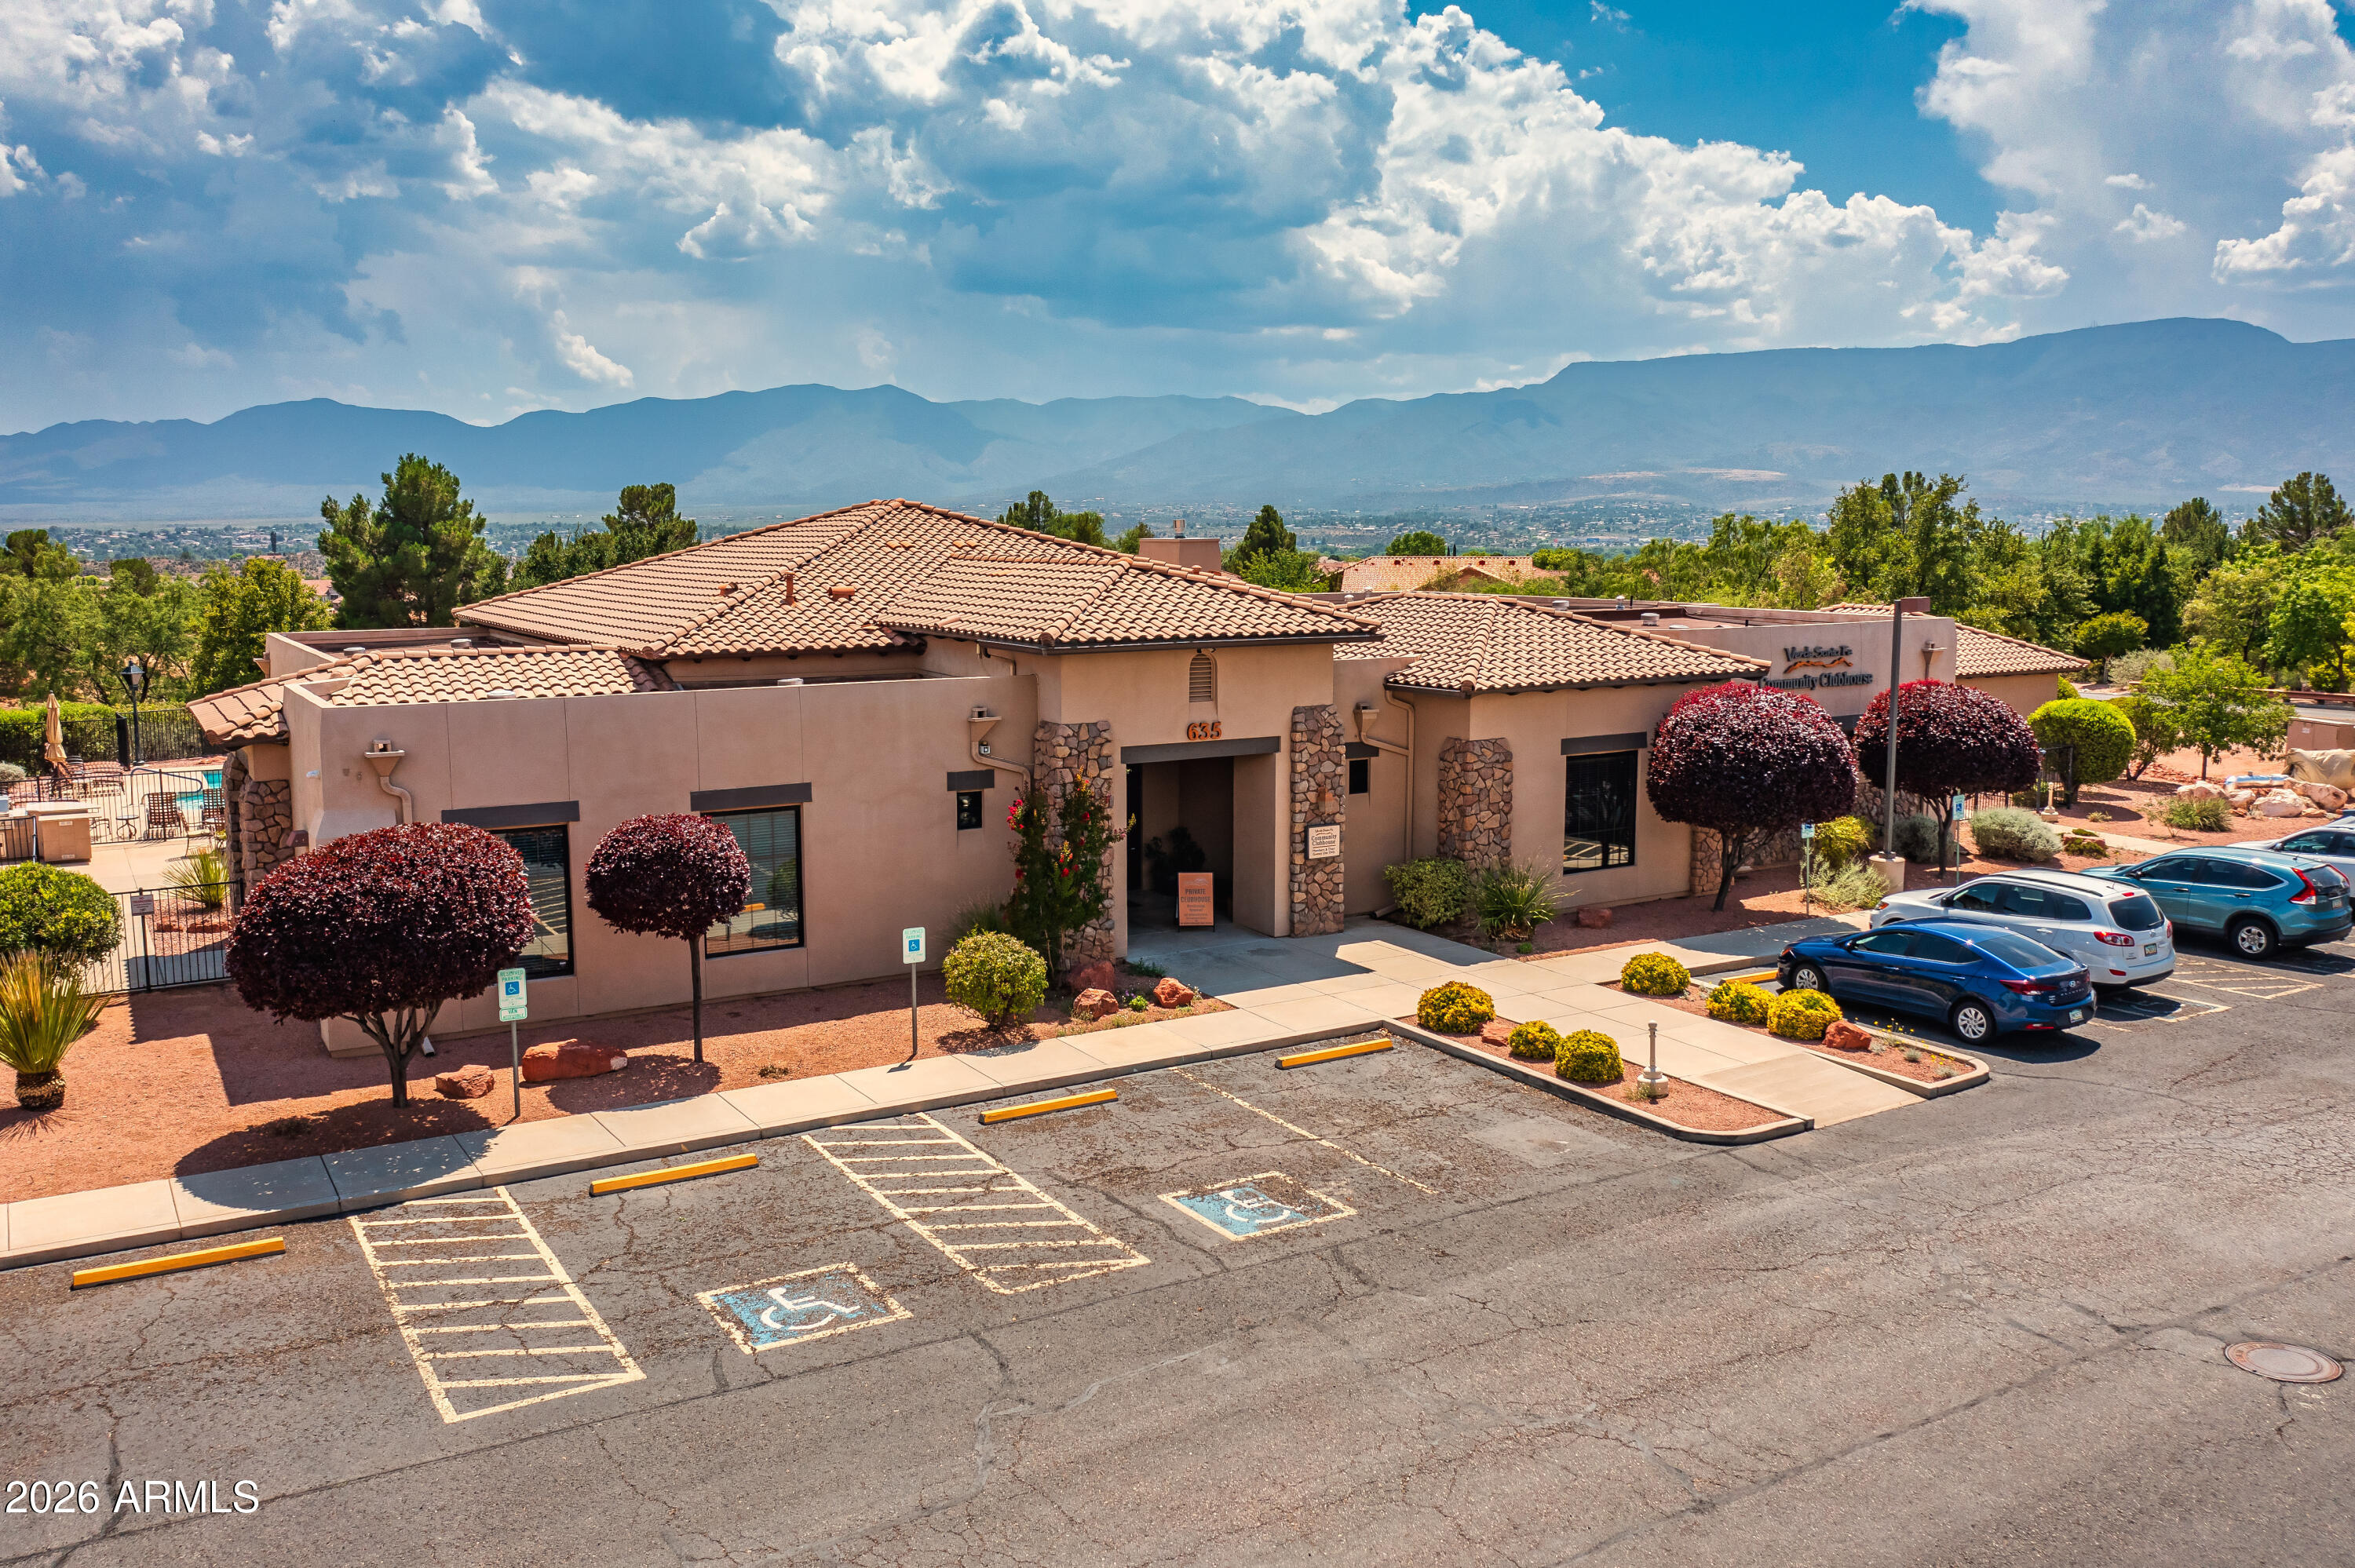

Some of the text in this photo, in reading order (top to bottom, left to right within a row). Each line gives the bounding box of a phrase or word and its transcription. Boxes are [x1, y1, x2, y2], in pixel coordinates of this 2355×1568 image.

[1813, 646, 1839, 658] Santa
[1839, 645, 1853, 656] Fe
[1758, 671, 1873, 691] Community Clubhouse
[1186, 721, 1222, 741] 635
